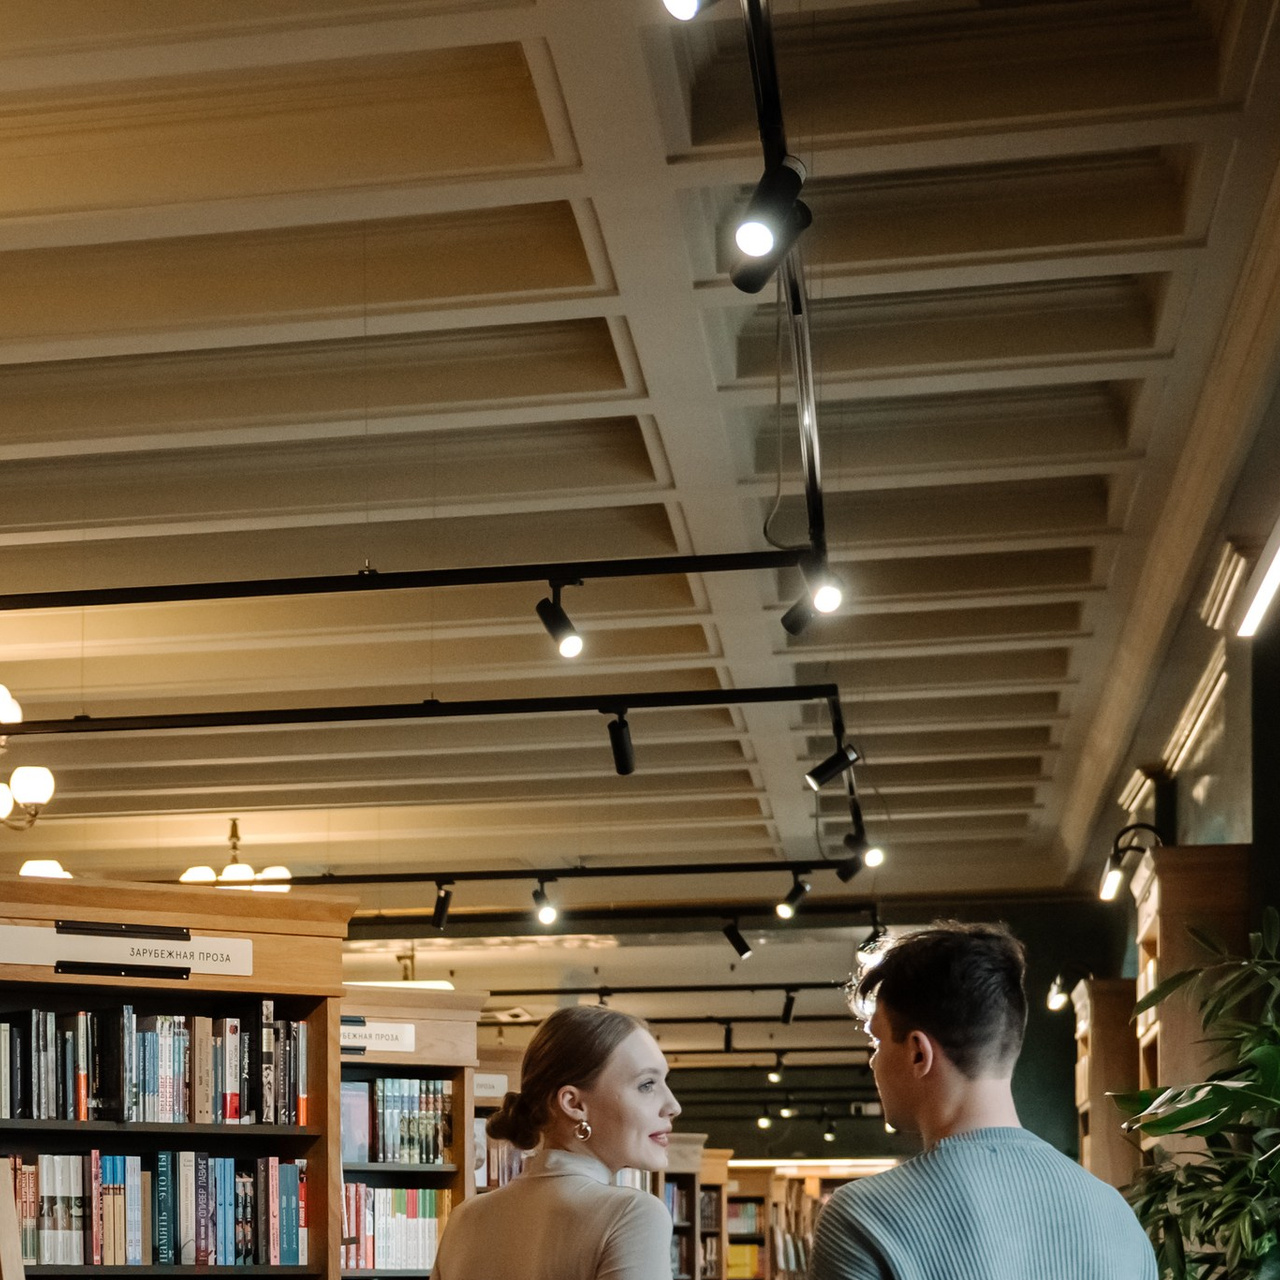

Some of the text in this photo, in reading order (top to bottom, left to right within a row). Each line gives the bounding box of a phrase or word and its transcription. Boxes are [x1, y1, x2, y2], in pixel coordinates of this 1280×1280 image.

[129, 947, 231, 963] ЗАРУБЕЖНАЯ ПРОЗА
[341, 1032, 400, 1041] БЕЖНАЯ ПРОЗА
[198, 1158, 206, 1186] ЛАВИНГ
[198, 1188, 207, 1216] ОЛИВЕР
